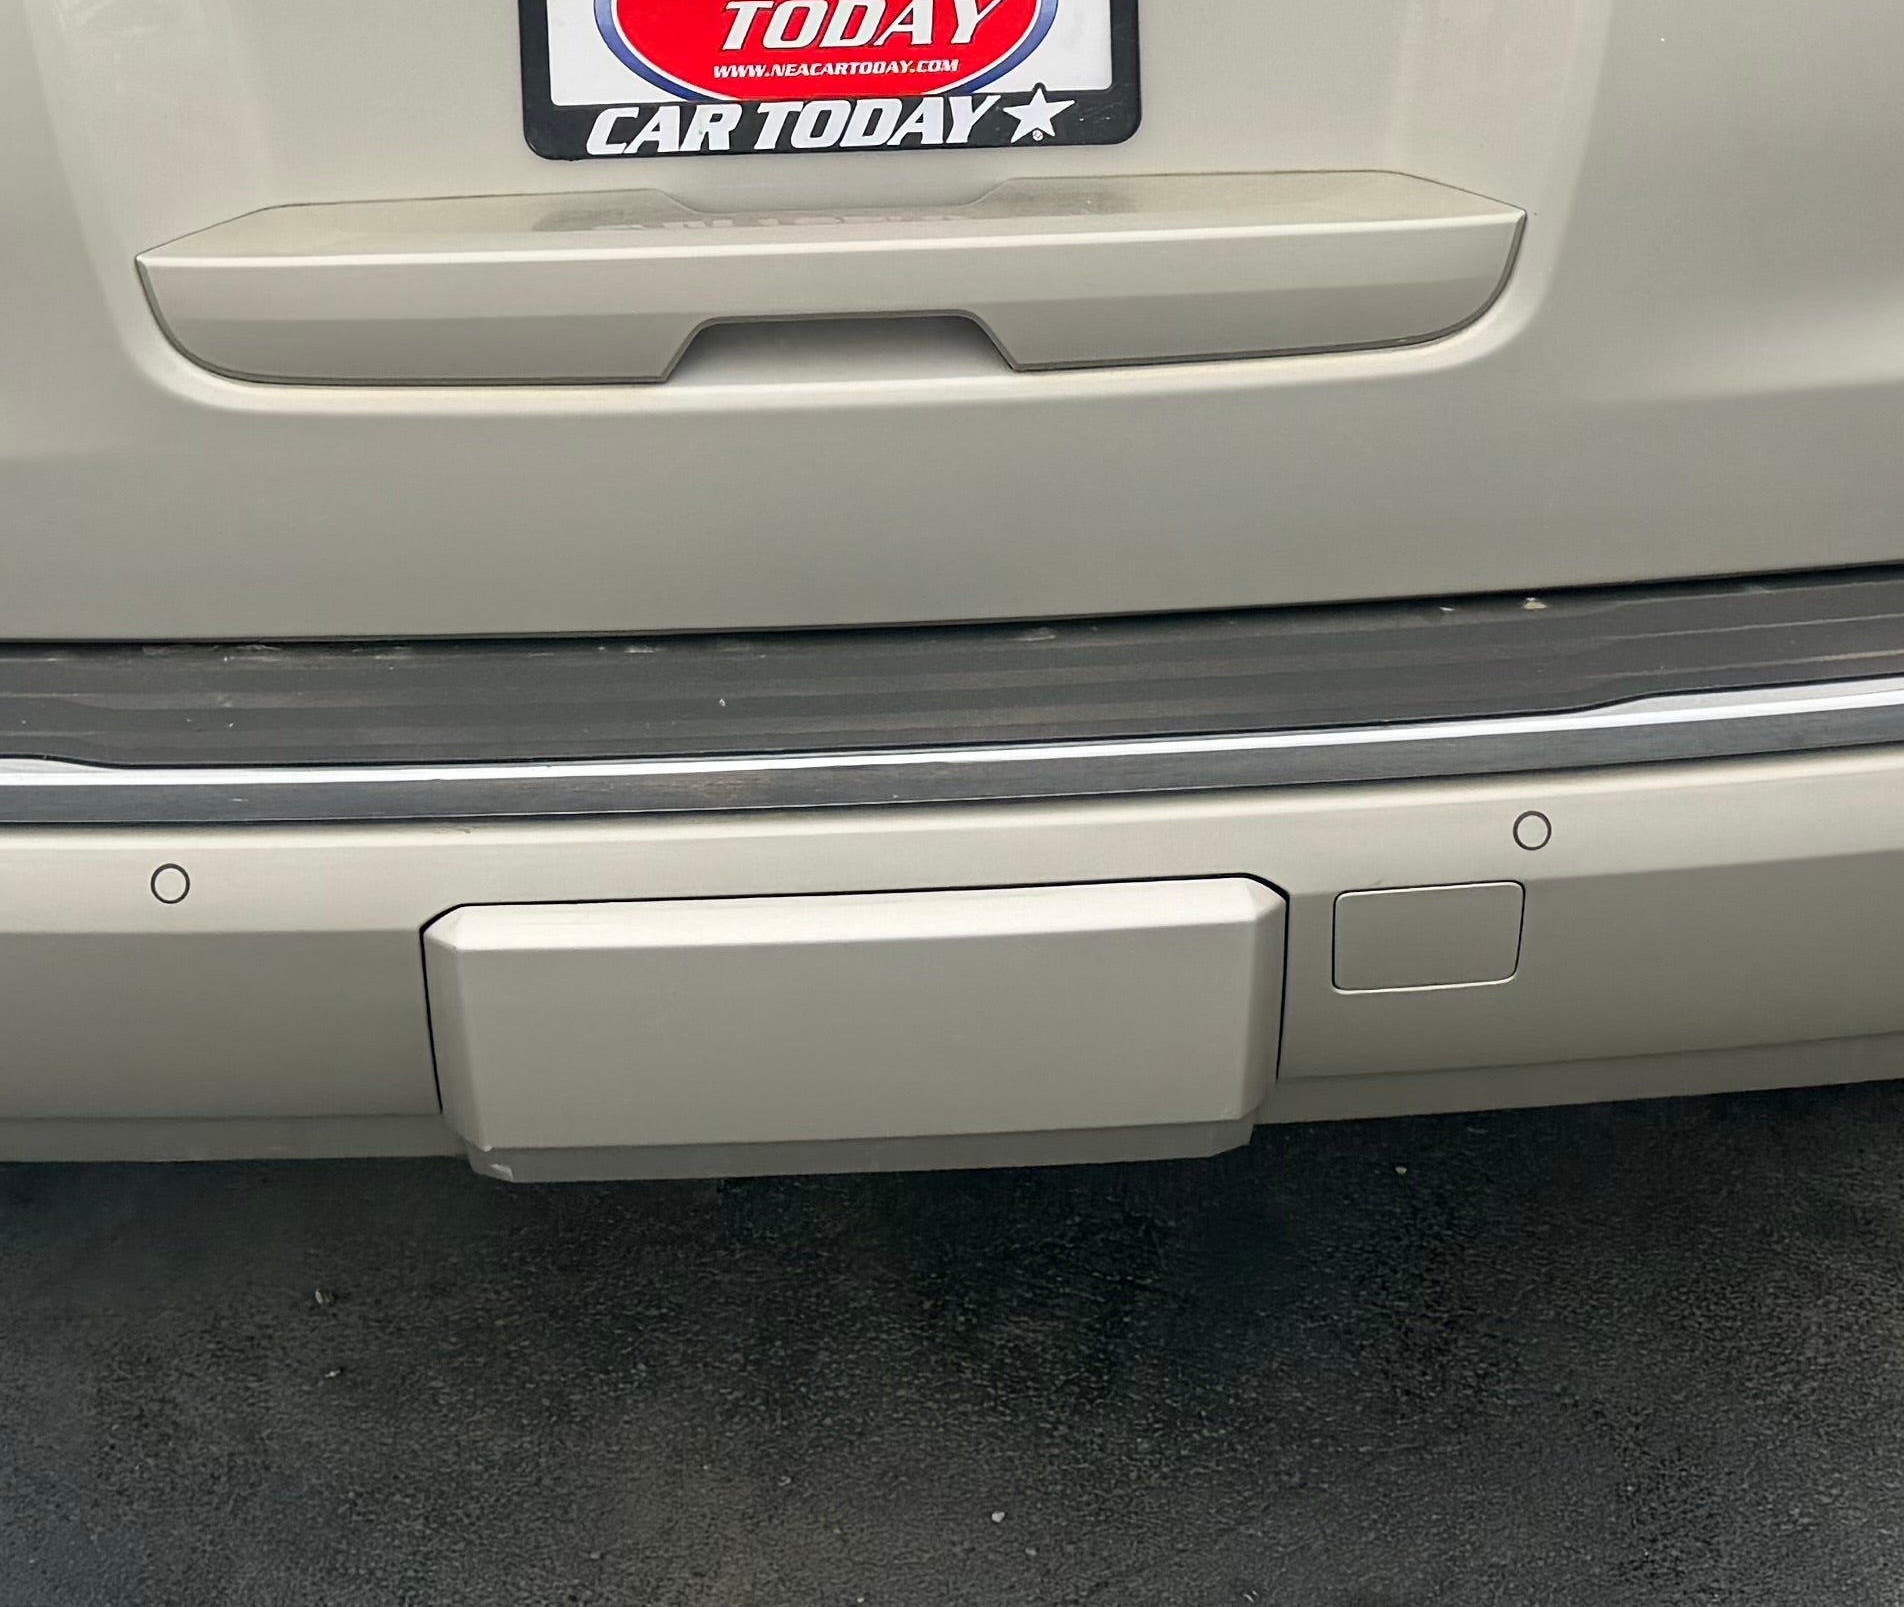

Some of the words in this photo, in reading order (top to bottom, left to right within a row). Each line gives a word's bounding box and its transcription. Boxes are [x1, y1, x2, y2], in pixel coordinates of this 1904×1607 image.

[713, 59, 959, 78] WWW.NEACARTODAY.COM
[586, 102, 742, 156] CAR
[758, 94, 1001, 153] TODAY
